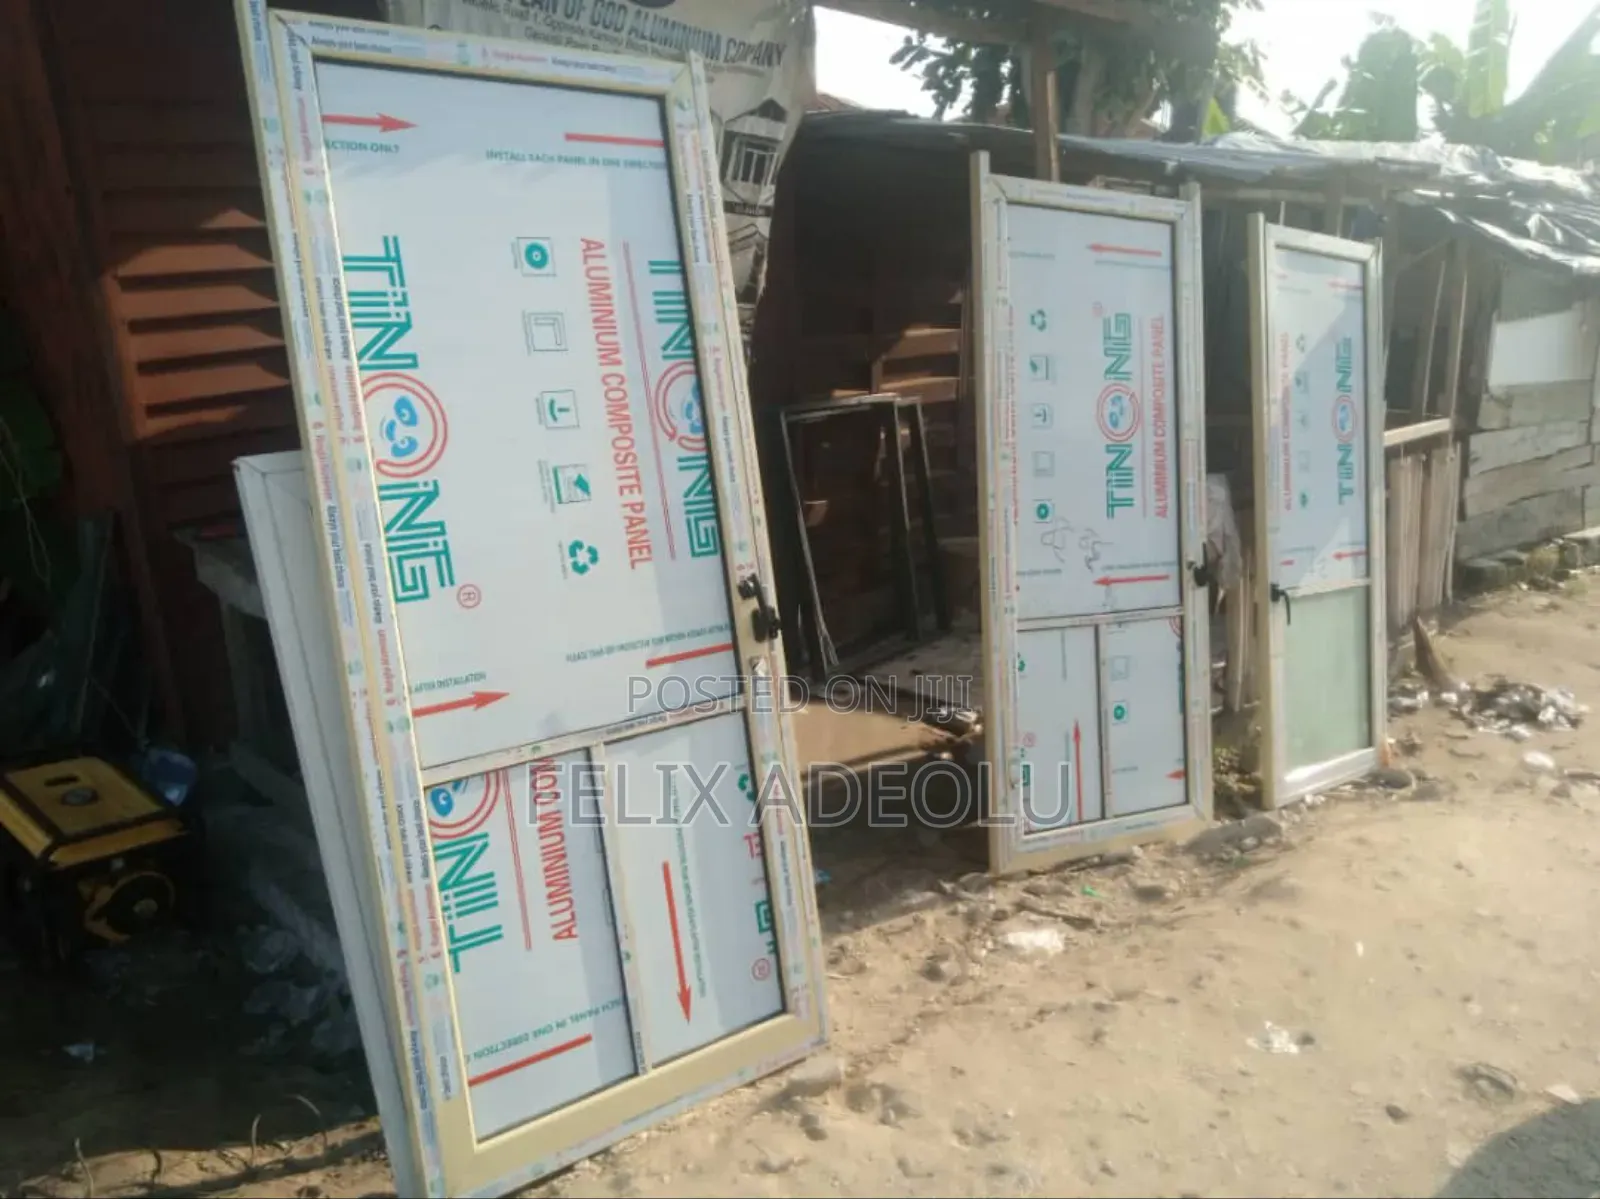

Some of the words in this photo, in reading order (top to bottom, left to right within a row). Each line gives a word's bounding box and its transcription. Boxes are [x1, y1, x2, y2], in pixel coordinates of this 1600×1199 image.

[590, 0, 629, 33] GOD
[580, 238, 623, 366] ALUMINIUM
[602, 372, 643, 497] COMPOSITE
[622, 502, 653, 570] PANEL
[436, 671, 487, 689] INSTALLATION
[536, 811, 579, 941] ALUMINIUM
[473, 1032, 530, 1060] DIRECTION
